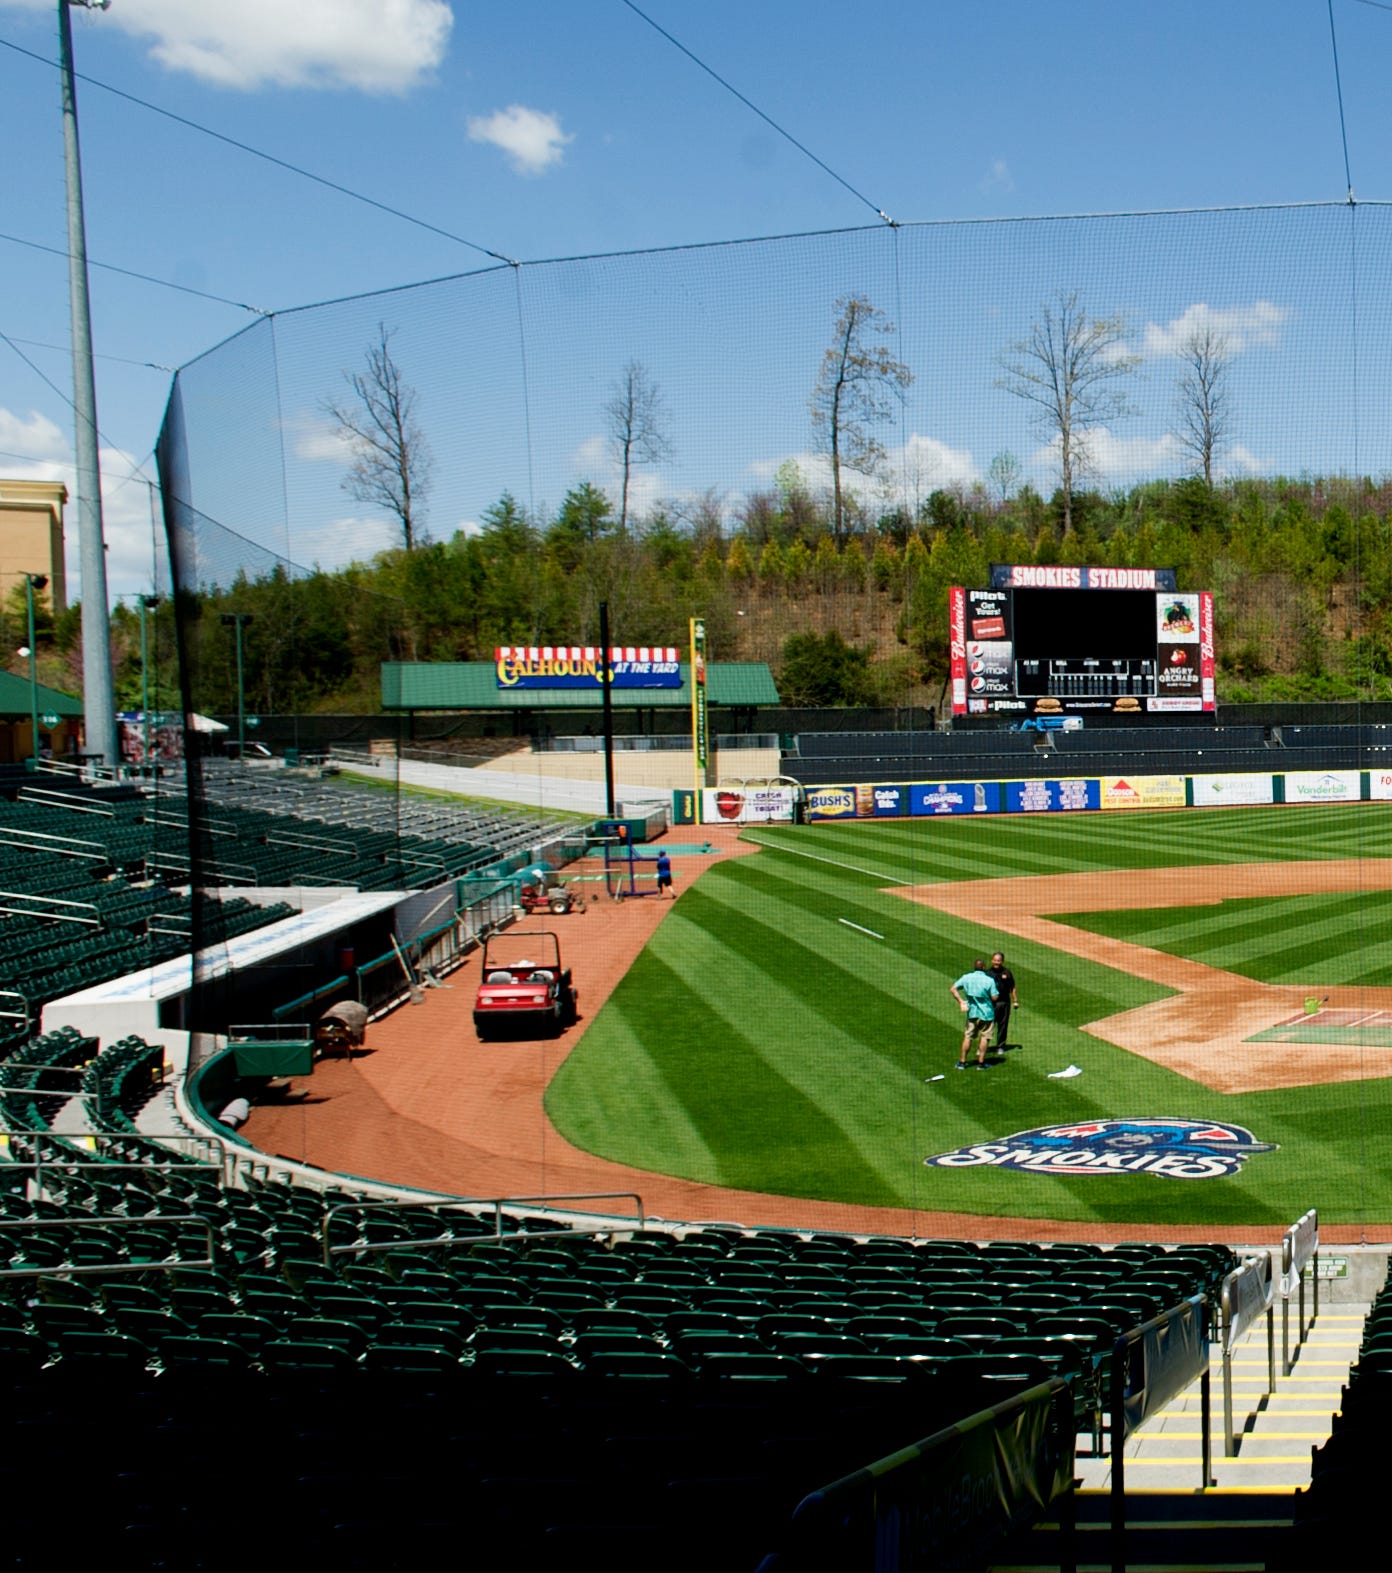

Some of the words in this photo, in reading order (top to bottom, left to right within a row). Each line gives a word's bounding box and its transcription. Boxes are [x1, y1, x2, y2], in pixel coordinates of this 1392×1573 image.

[1011, 565, 1081, 587] SMOKIES
[1088, 567, 1156, 588] STADIUM
[950, 590, 966, 661] Budweiser
[1201, 594, 1214, 661] Budweiser
[614, 662, 631, 674] AT
[631, 662, 651, 674] THE
[652, 662, 679, 675] YARD
[985, 666, 1008, 675] max
[1163, 667, 1194, 675] ANGRY
[1158, 674, 1199, 683] ORCHARD
[985, 682, 1008, 691] max
[1297, 784, 1347, 795] Vanderbilt
[810, 794, 852, 809] BUSH'S
[936, 1145, 1237, 1179] SMOKIES
